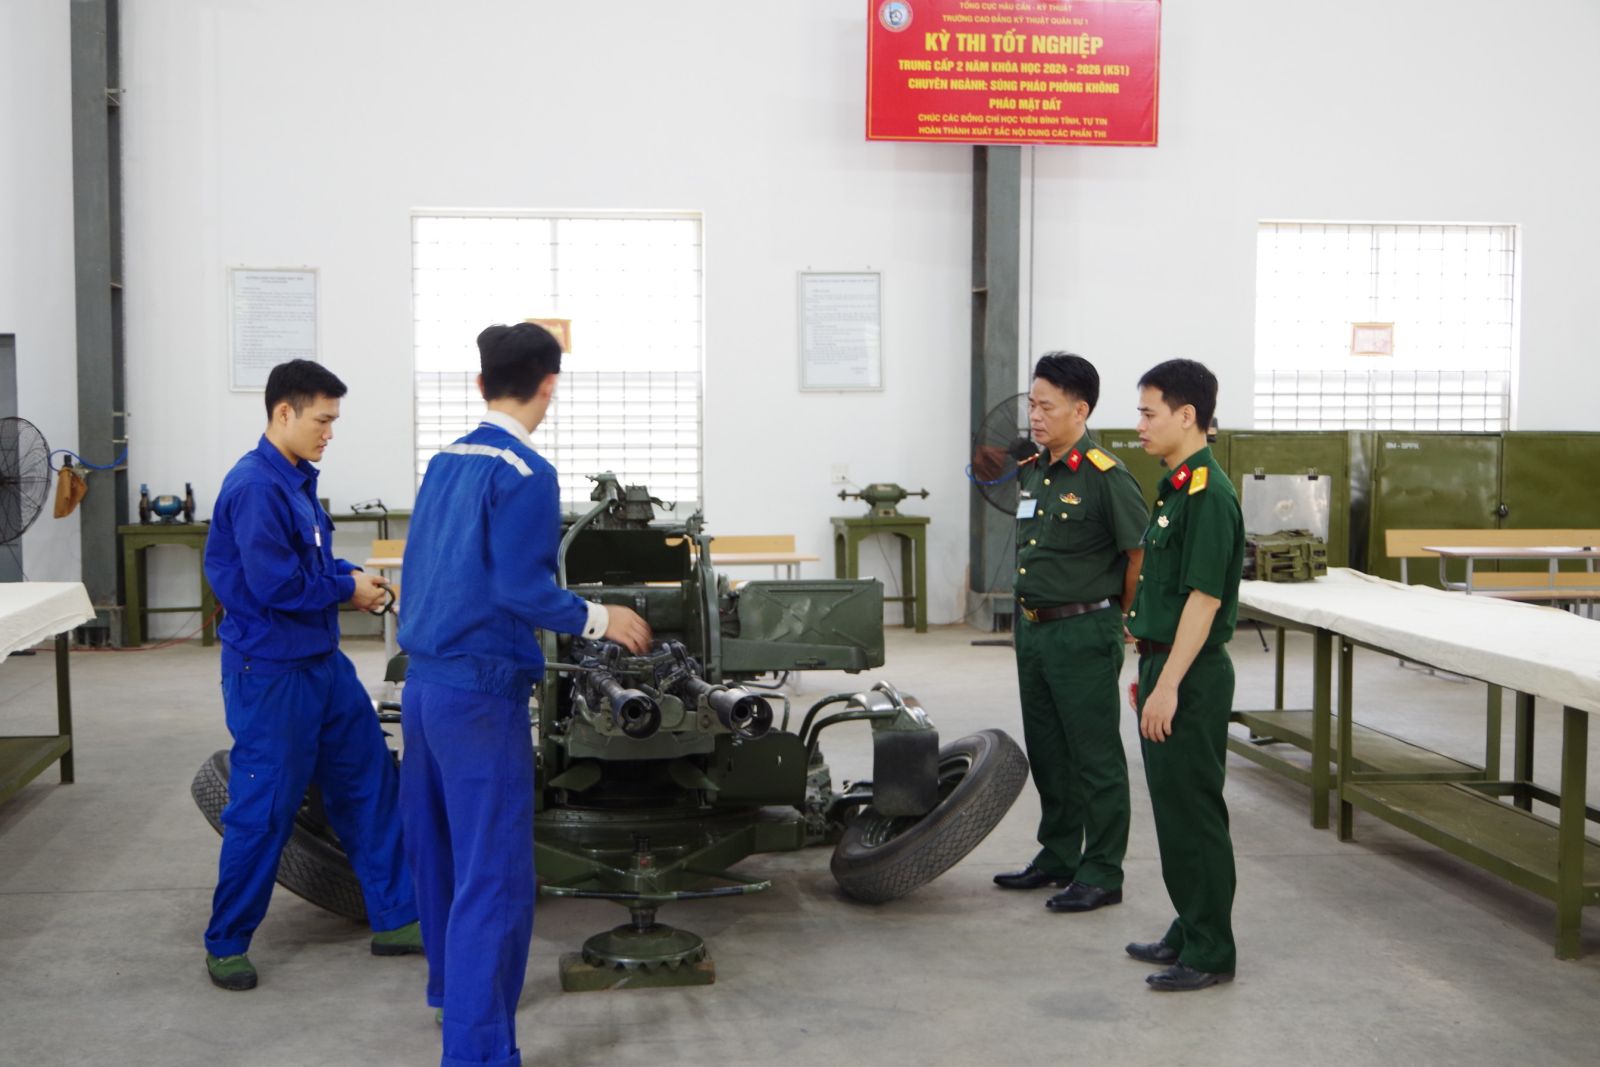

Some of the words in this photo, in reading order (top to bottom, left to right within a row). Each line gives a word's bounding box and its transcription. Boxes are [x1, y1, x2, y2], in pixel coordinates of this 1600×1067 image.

[975, 15, 990, 23] CAO
[925, 29, 950, 52] KỲ
[956, 33, 986, 52] THI
[992, 28, 1027, 53] TỐT
[1032, 31, 1104, 59] NGHIỆP
[898, 59, 932, 71] TRUNG
[934, 57, 955, 72] CẤP
[957, 61, 963, 72] 2
[965, 60, 989, 73] NĂM
[991, 60, 1019, 73] KHÓA
[1020, 62, 1041, 76] HỌC
[1043, 63, 1068, 75] 2024
[1103, 64, 1130, 77] (K51)
[908, 77, 948, 90] CHUYÊN
[950, 77, 988, 91] NGÀNH:
[990, 78, 1018, 91] SÚNG
[1020, 79, 1047, 92] PHÁO
[1049, 79, 1083, 93] PHÒNG
[1085, 80, 1120, 94] KHÔNG
[989, 97, 1017, 109] PHÁO
[1042, 96, 1063, 111] ĐẤT
[918, 113, 941, 122] CHÚC
[942, 113, 960, 122] CÁC
[960, 112, 984, 123] ĐỒNG
[1001, 115, 1018, 124] HỌC
[1095, 118, 1108, 126] TIN
[918, 126, 942, 134] HOÀN
[943, 125, 970, 135] THÀNH
[972, 125, 993, 135] XUẤT
[1011, 127, 1026, 137] NỘI
[1027, 129, 1050, 137] DUNG
[1051, 128, 1069, 137] CÁC
[1093, 130, 1107, 138] THI
